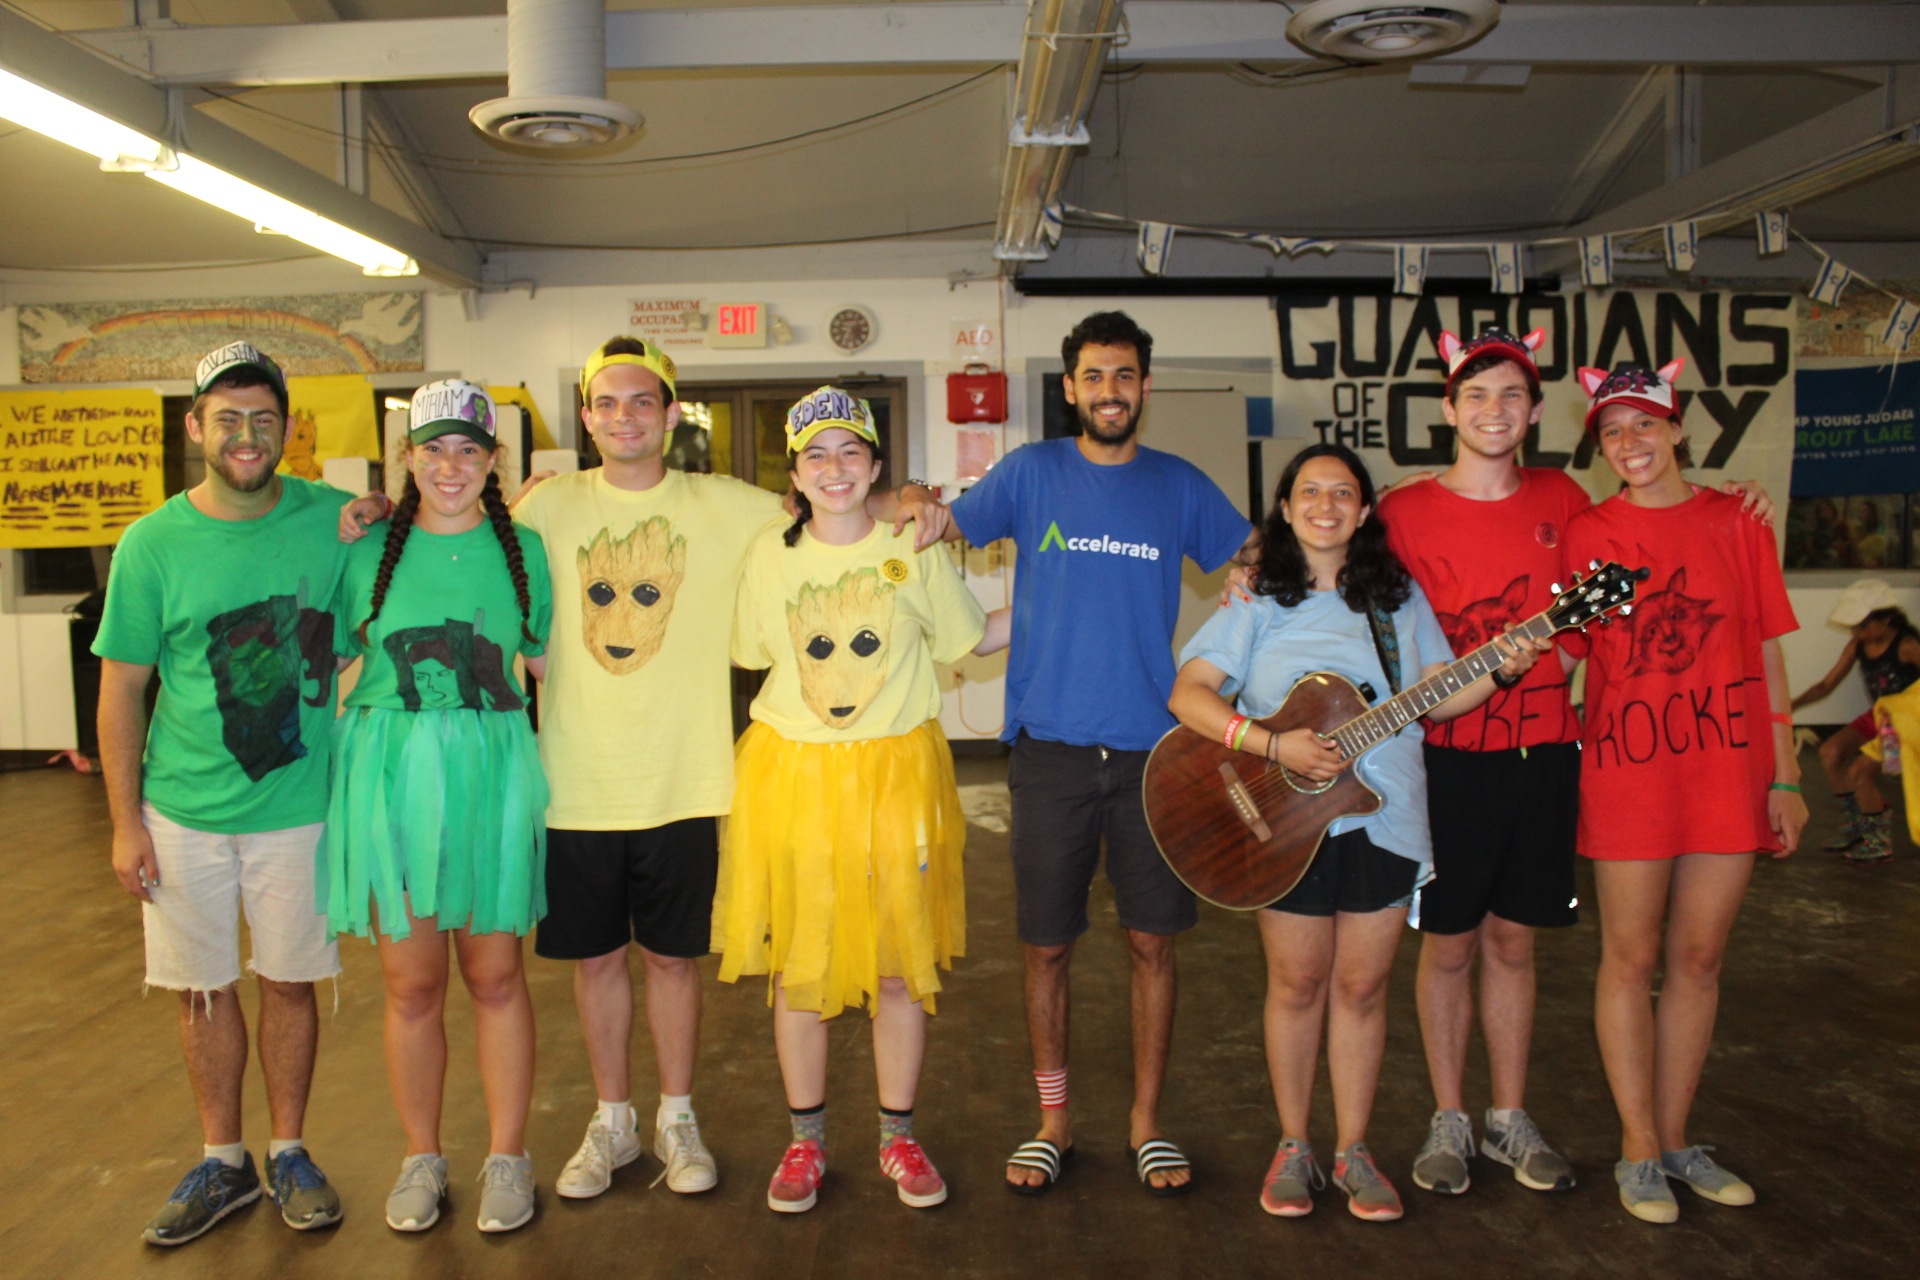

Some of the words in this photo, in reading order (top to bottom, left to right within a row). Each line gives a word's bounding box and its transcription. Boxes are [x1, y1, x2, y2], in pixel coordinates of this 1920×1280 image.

[630, 314, 682, 326] OCCUPA
[633, 301, 700, 312] MAXIMUM
[719, 304, 758, 334] EXIT
[956, 330, 993, 346] AED
[414, 389, 464, 427] MIRIAM
[1333, 382, 1385, 418] OF
[10, 405, 46, 424] WE
[791, 392, 851, 436] EDEN
[1813, 415, 1862, 428] YOUNG
[1864, 409, 1914, 424] JUDAEA
[1313, 420, 1386, 449] THE
[1796, 429, 1858, 449] ROUT
[1863, 424, 1916, 445] LAKE
[1038, 520, 1160, 561] Accelerate
